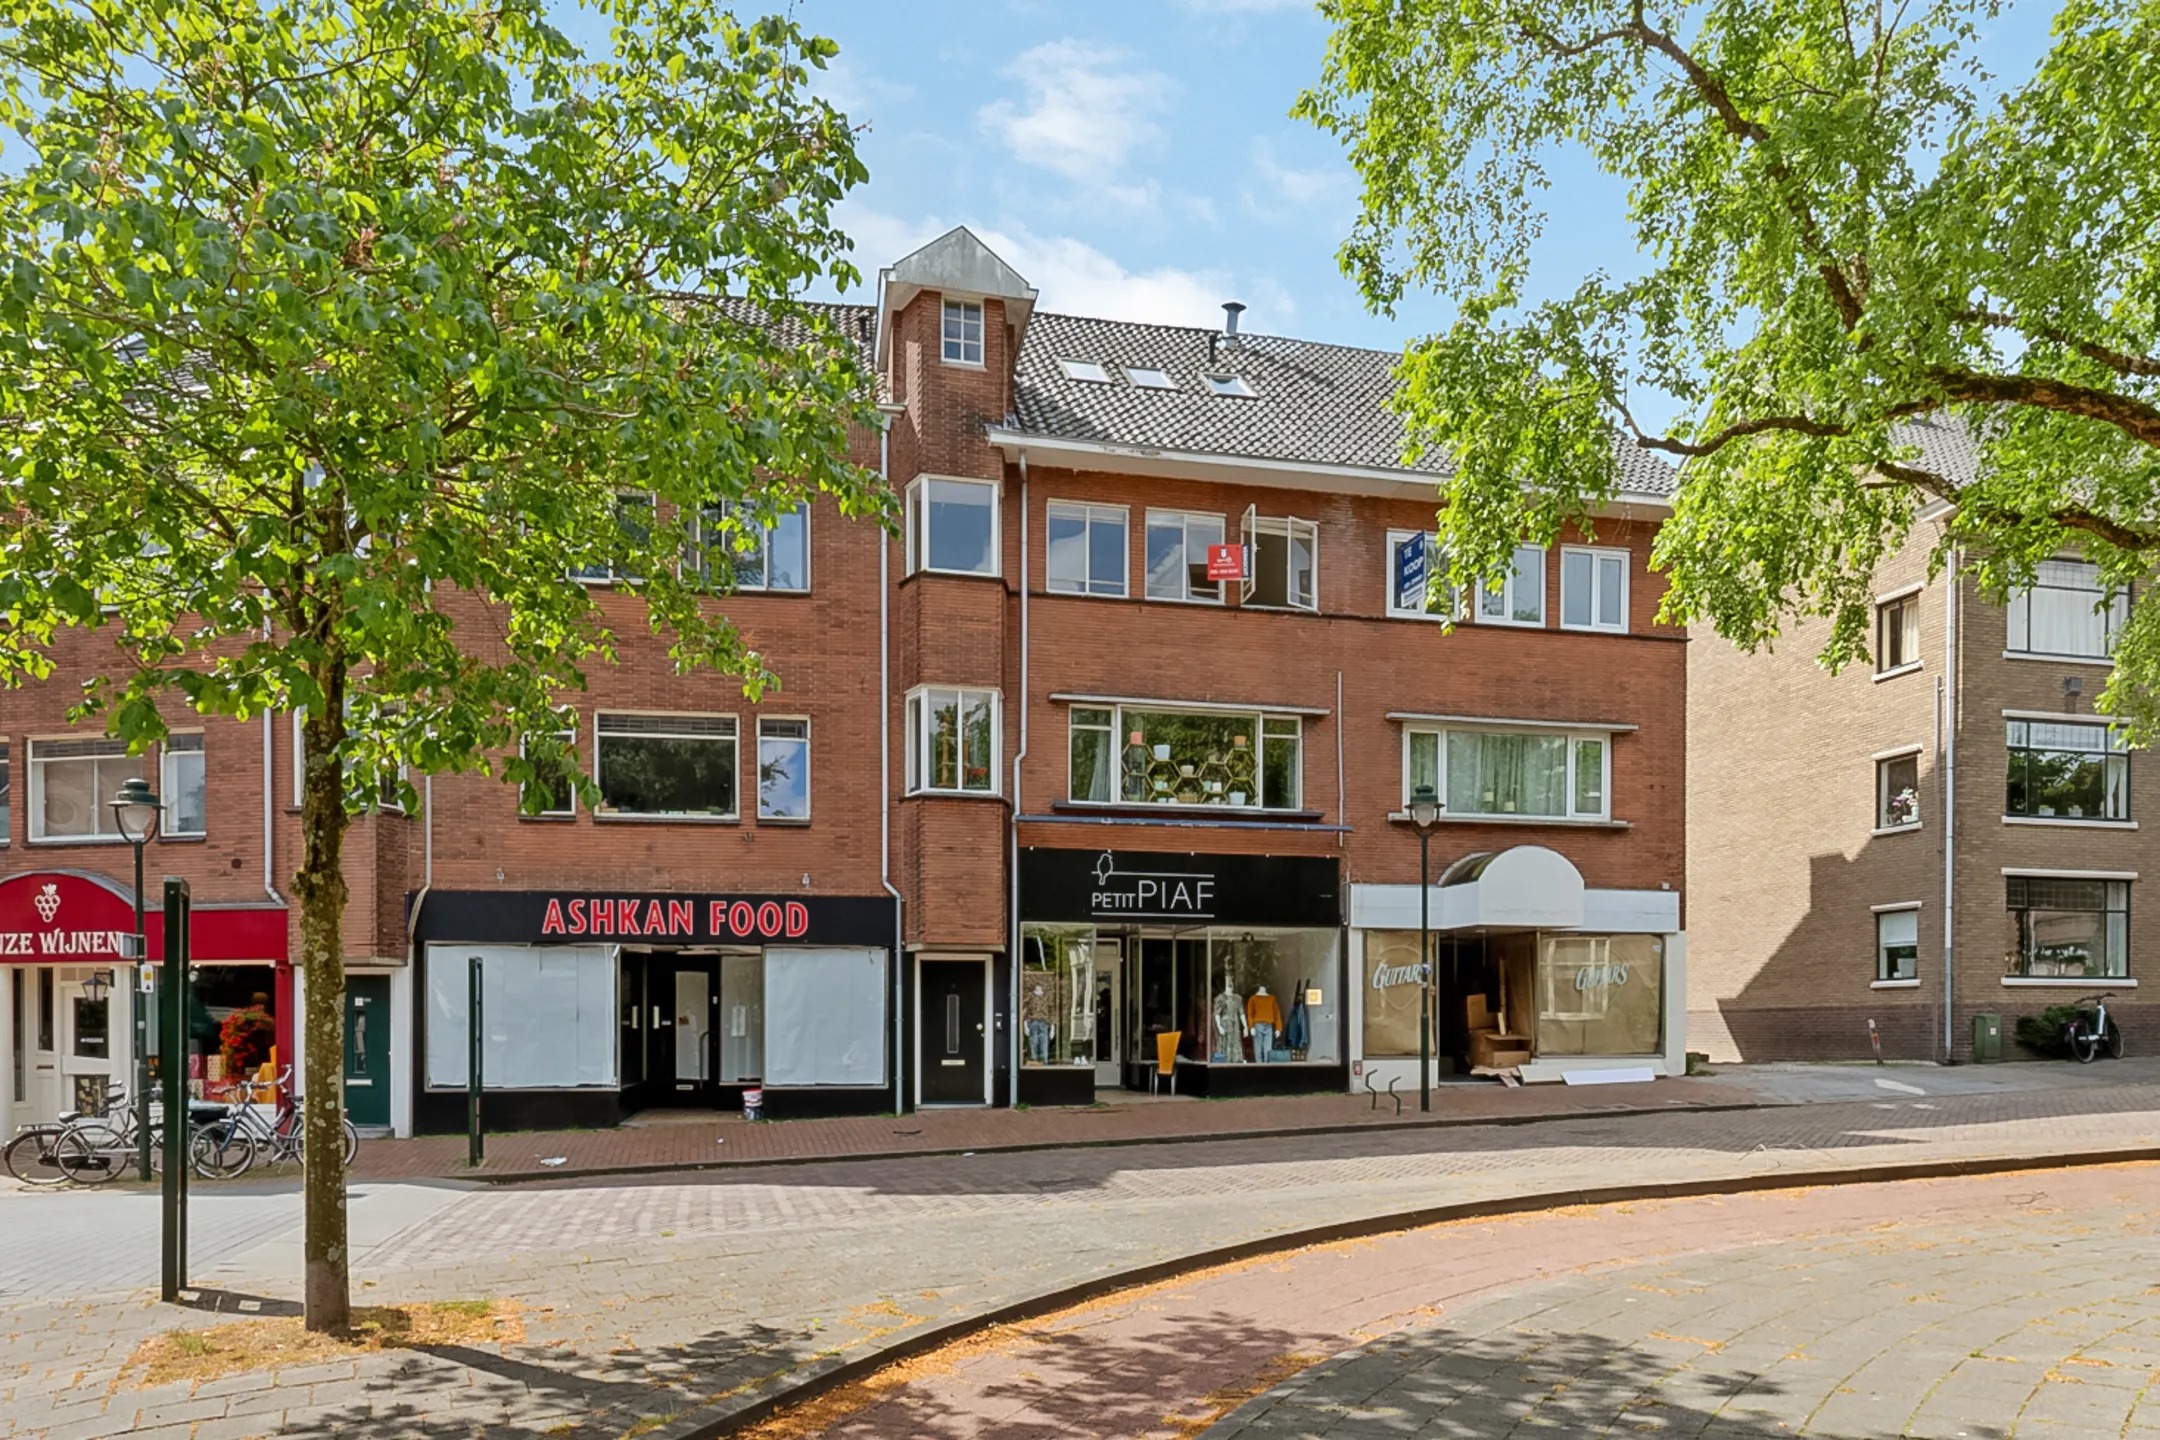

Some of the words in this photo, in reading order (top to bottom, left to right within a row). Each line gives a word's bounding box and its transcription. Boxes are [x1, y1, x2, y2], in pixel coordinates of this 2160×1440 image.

[1403, 546, 1412, 560] TE
[1403, 556, 1424, 577] KOOP
[1091, 892, 1136, 908] PETIT
[1138, 880, 1215, 910] PIAF
[541, 898, 694, 935] ASHKAN
[709, 900, 809, 938] FOOD
[38, 927, 121, 955] WIJNEN
